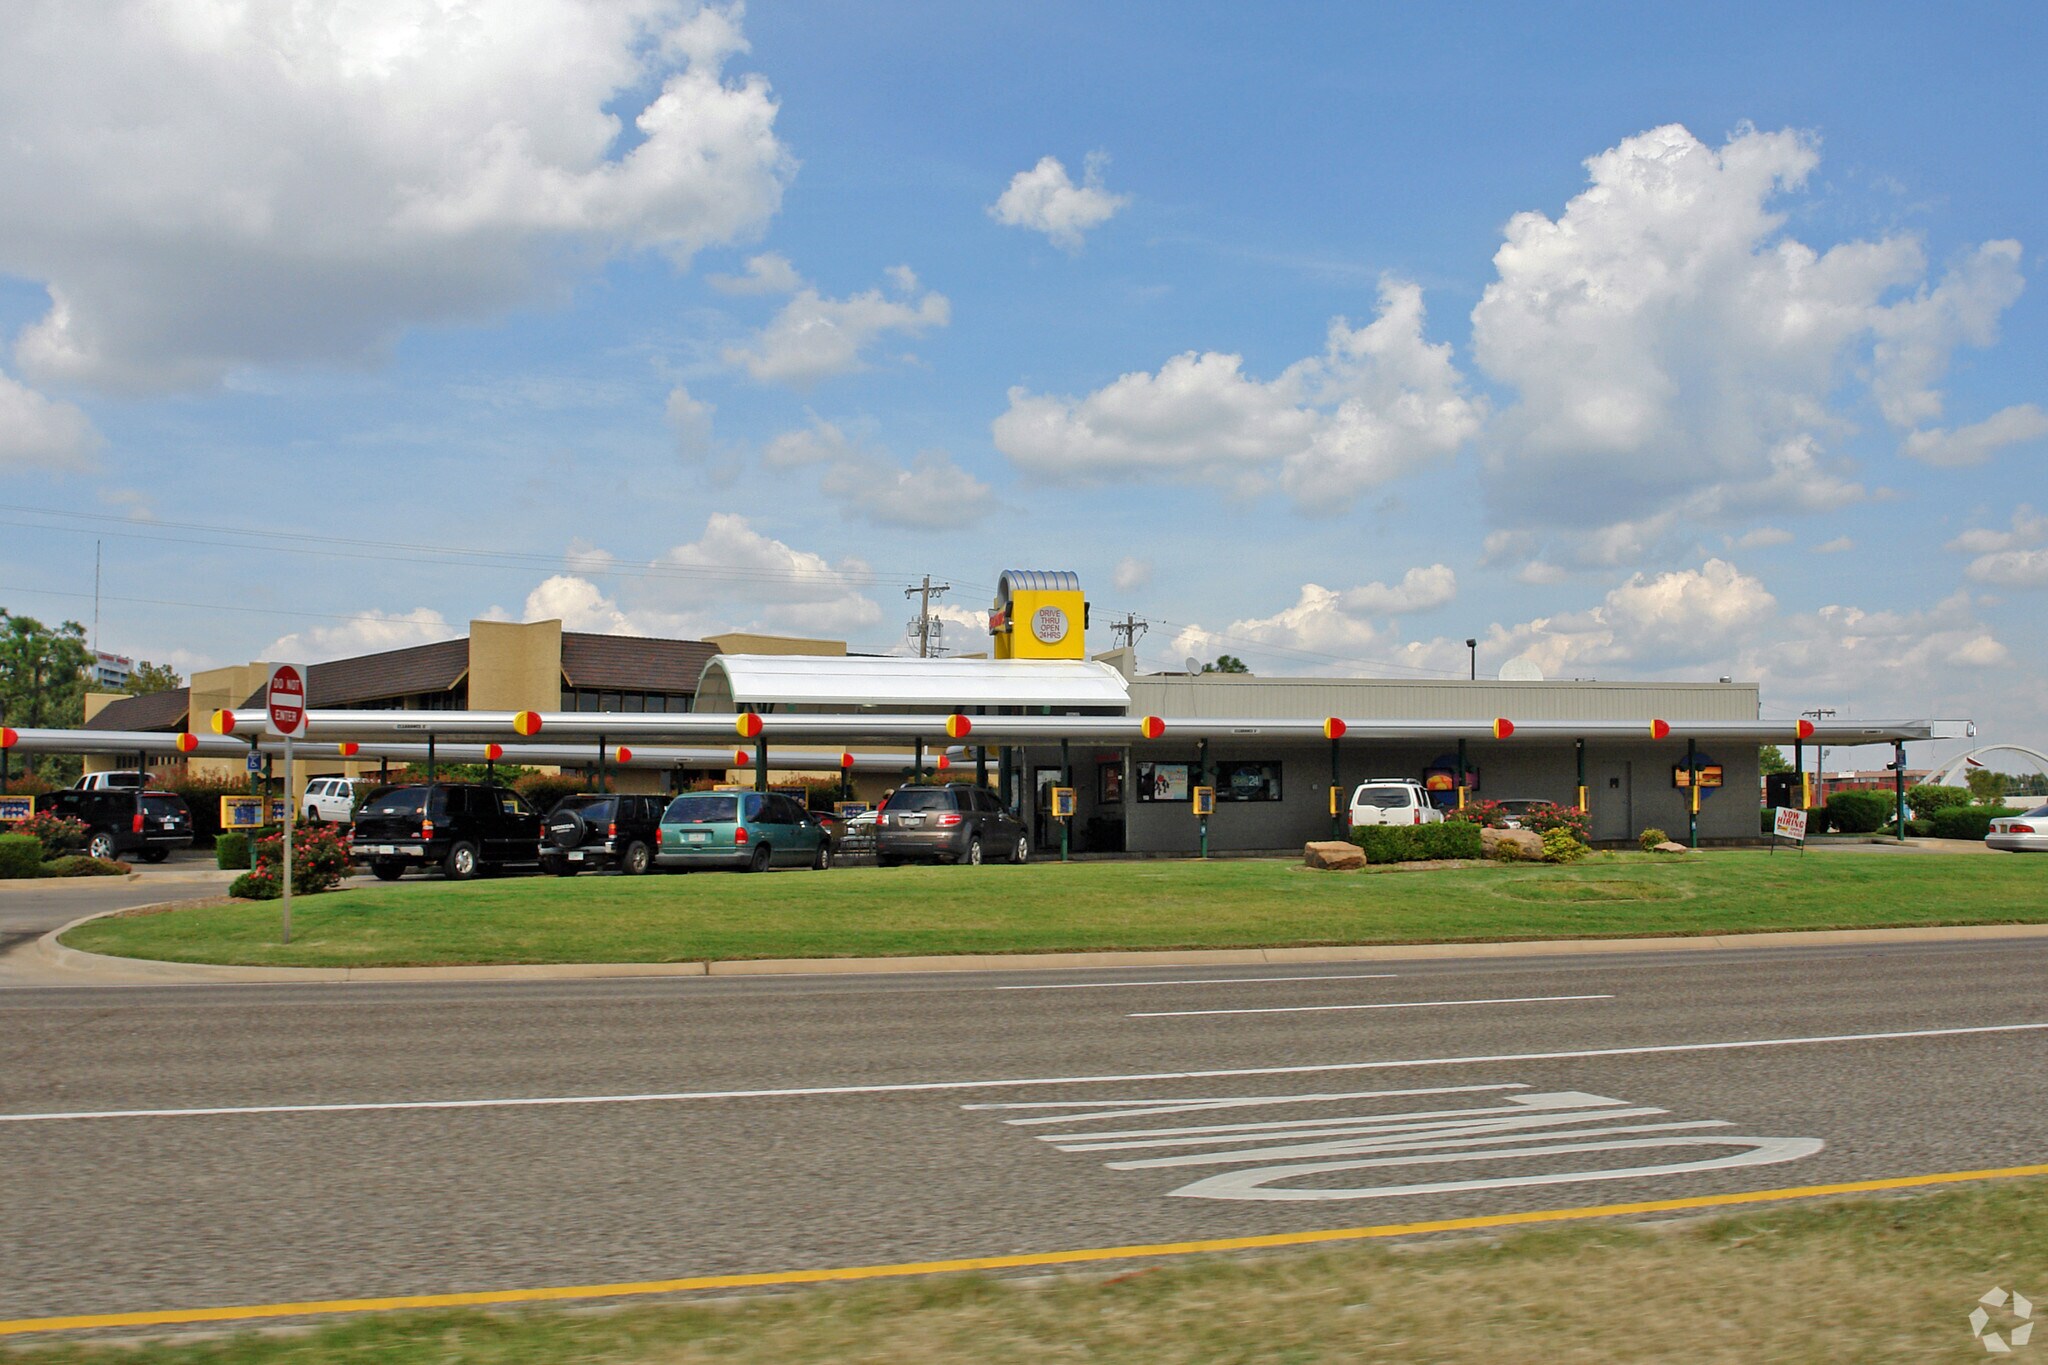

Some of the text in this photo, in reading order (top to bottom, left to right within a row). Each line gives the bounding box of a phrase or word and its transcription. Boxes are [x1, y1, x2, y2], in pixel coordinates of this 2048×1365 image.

[1039, 609, 1061, 617] DRIVE
[273, 678, 300, 691] DO NOT
[274, 709, 297, 722] ENTER
[1248, 775, 1259, 786] 24
[1782, 809, 1800, 819] NOW
[550, 823, 576, 831] HONDA
[1776, 816, 1804, 828] HIRING
[960, 1083, 1825, 1201] ONLY
